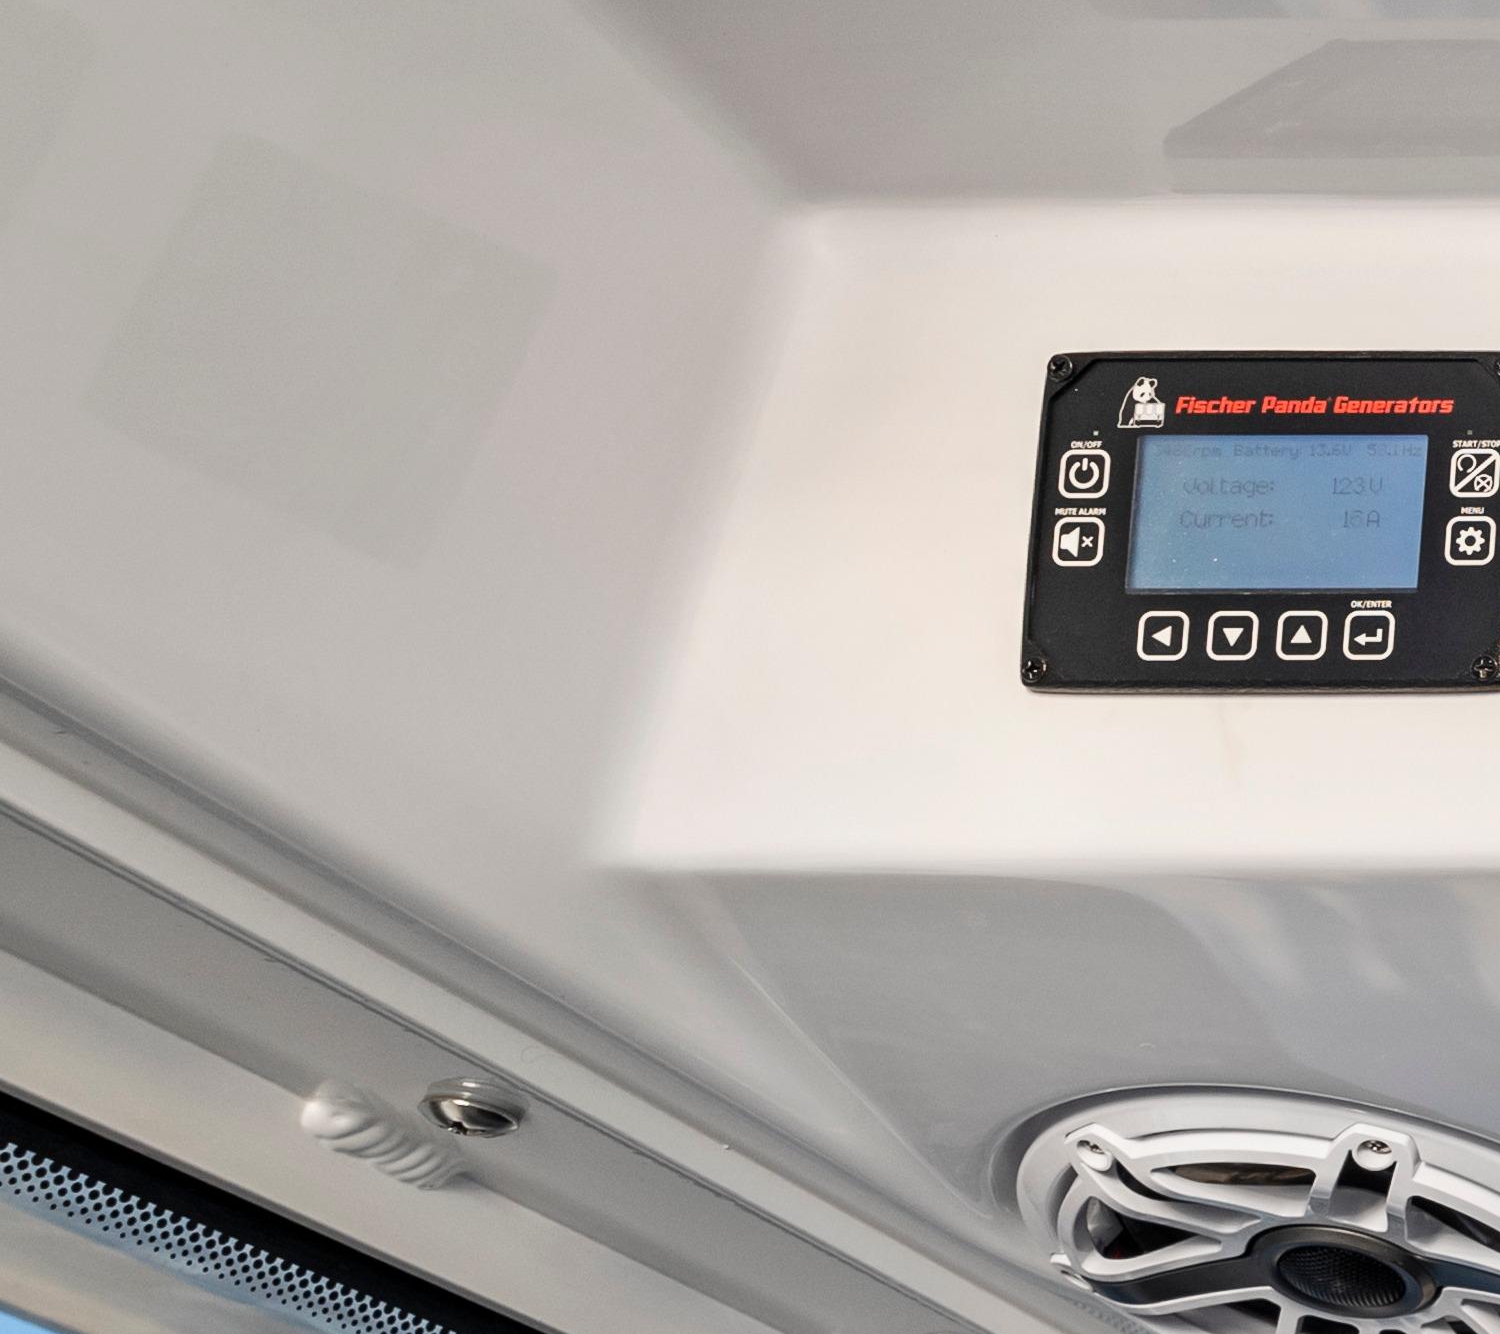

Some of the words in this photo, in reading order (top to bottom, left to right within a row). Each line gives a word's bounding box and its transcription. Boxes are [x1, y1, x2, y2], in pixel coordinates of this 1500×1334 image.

[1175, 396, 1256, 414] Fischer
[1261, 396, 1326, 414] Panda
[1333, 396, 1454, 414] Generators
[1183, 478, 1275, 497] Voltage:
[1180, 510, 1274, 528] Current:
[1350, 600, 1392, 609] OK/ENTER
